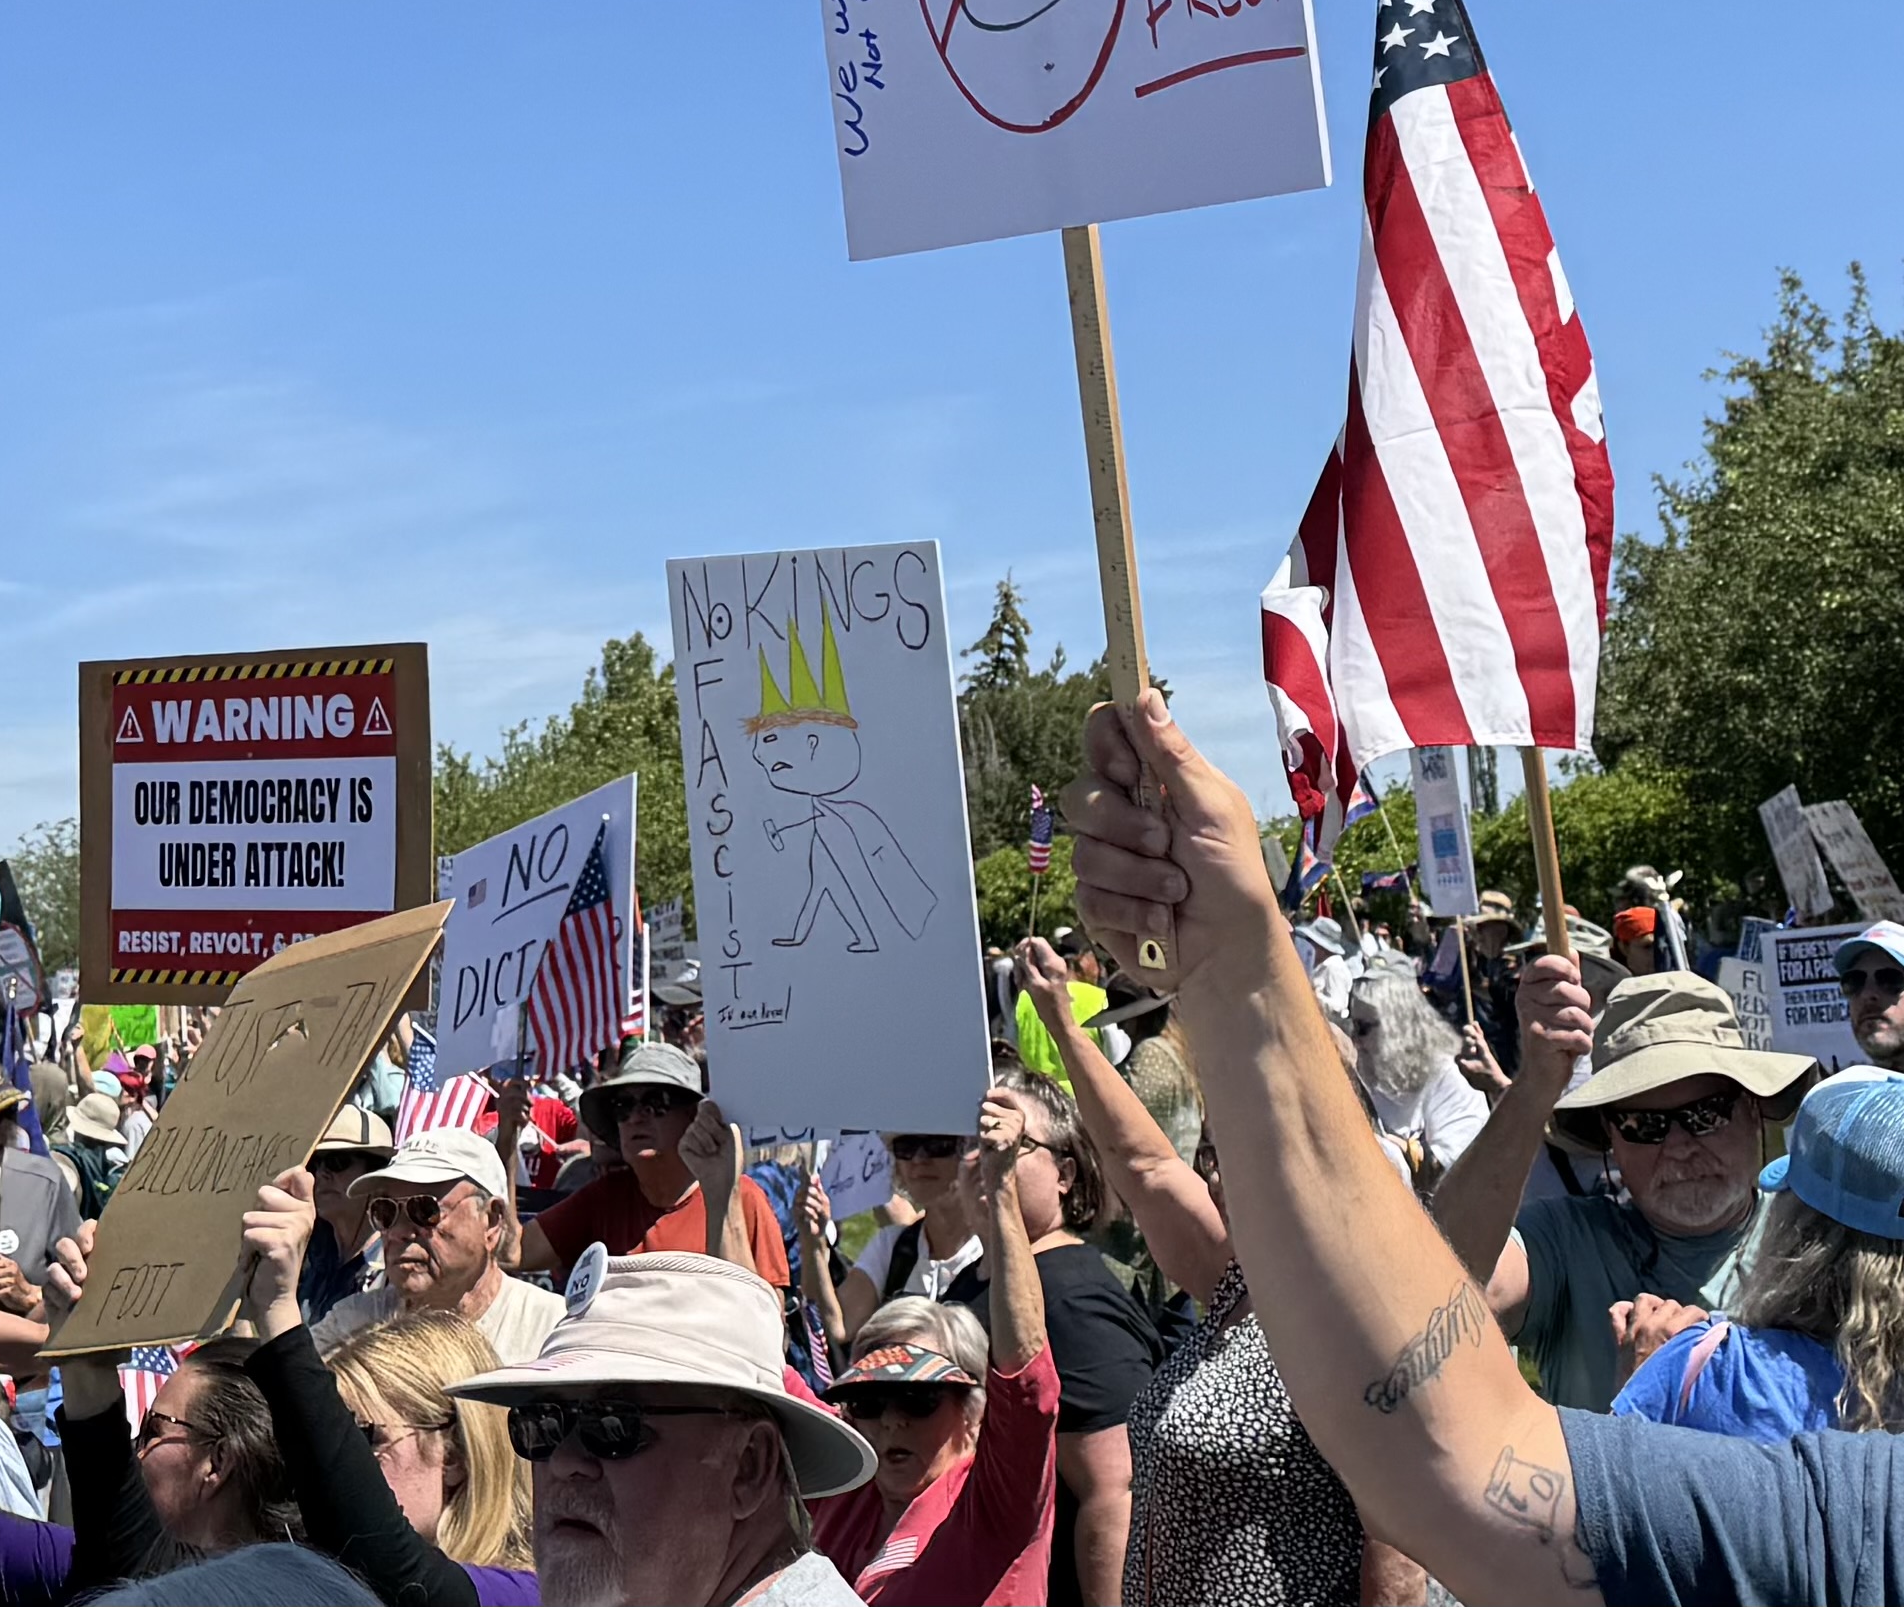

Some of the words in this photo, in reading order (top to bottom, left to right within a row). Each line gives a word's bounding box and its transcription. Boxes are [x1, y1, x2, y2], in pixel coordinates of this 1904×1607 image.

[151, 693, 355, 744] WARNING
[134, 780, 181, 826] OUR
[188, 776, 341, 825] DEMOCRACY
[349, 776, 373, 824] IS
[159, 842, 236, 888] UNDER
[244, 841, 345, 888] ATTACK!
[502, 823, 569, 908] NO
[118, 931, 186, 957] RESIST,
[189, 931, 268, 958] REVOLT,
[1779, 962, 1804, 982] FOR
[184, 999, 302, 1096] JUST
